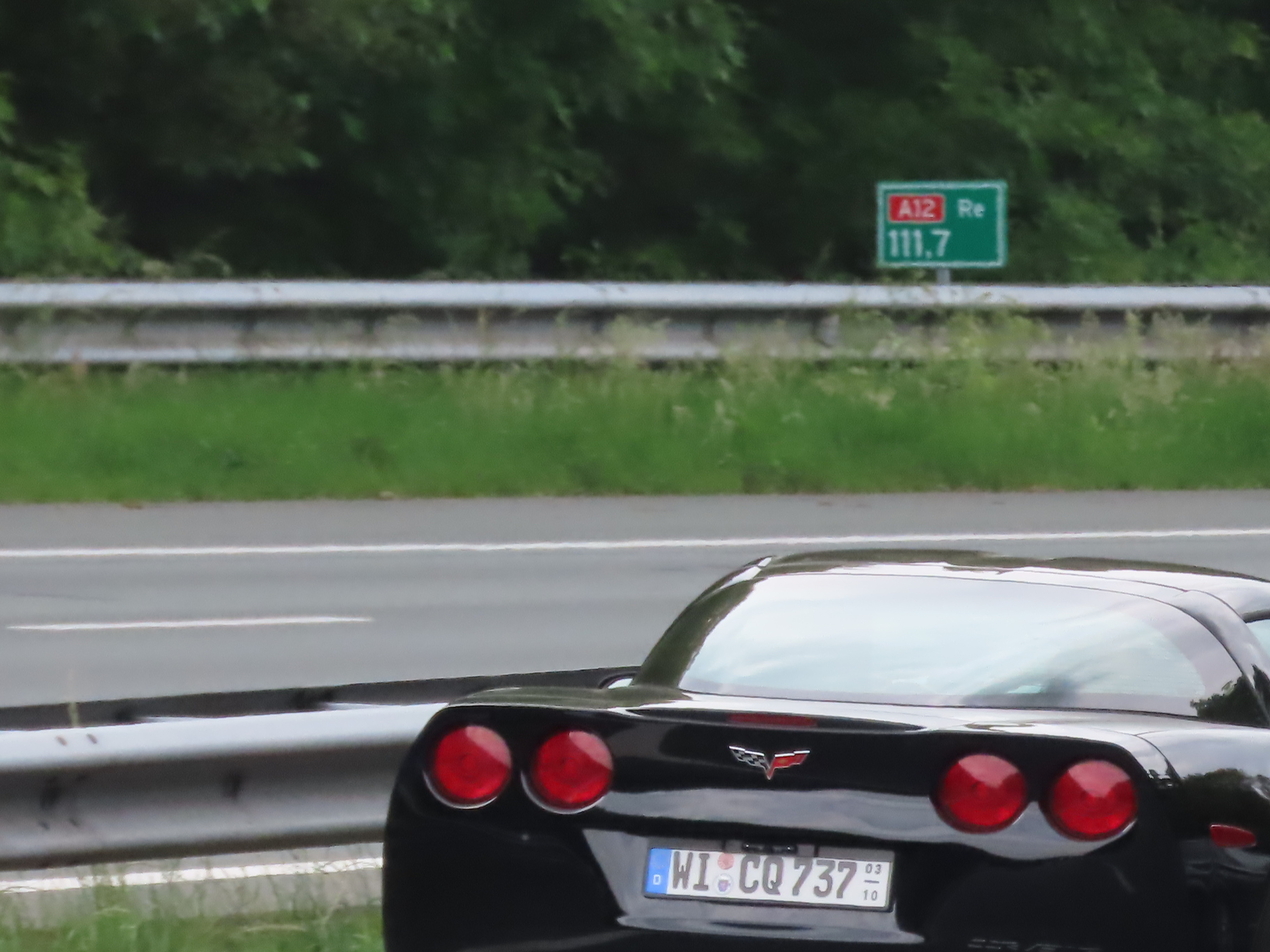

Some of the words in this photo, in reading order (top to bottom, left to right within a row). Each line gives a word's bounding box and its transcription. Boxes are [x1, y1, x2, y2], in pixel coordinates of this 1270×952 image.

[898, 199, 937, 219] A12
[957, 199, 985, 218] Re
[888, 229, 951, 258] 111.7
[672, 851, 710, 891] WI
[792, 856, 858, 899] 737
[865, 863, 881, 875] 03
[863, 889, 878, 901] 10
